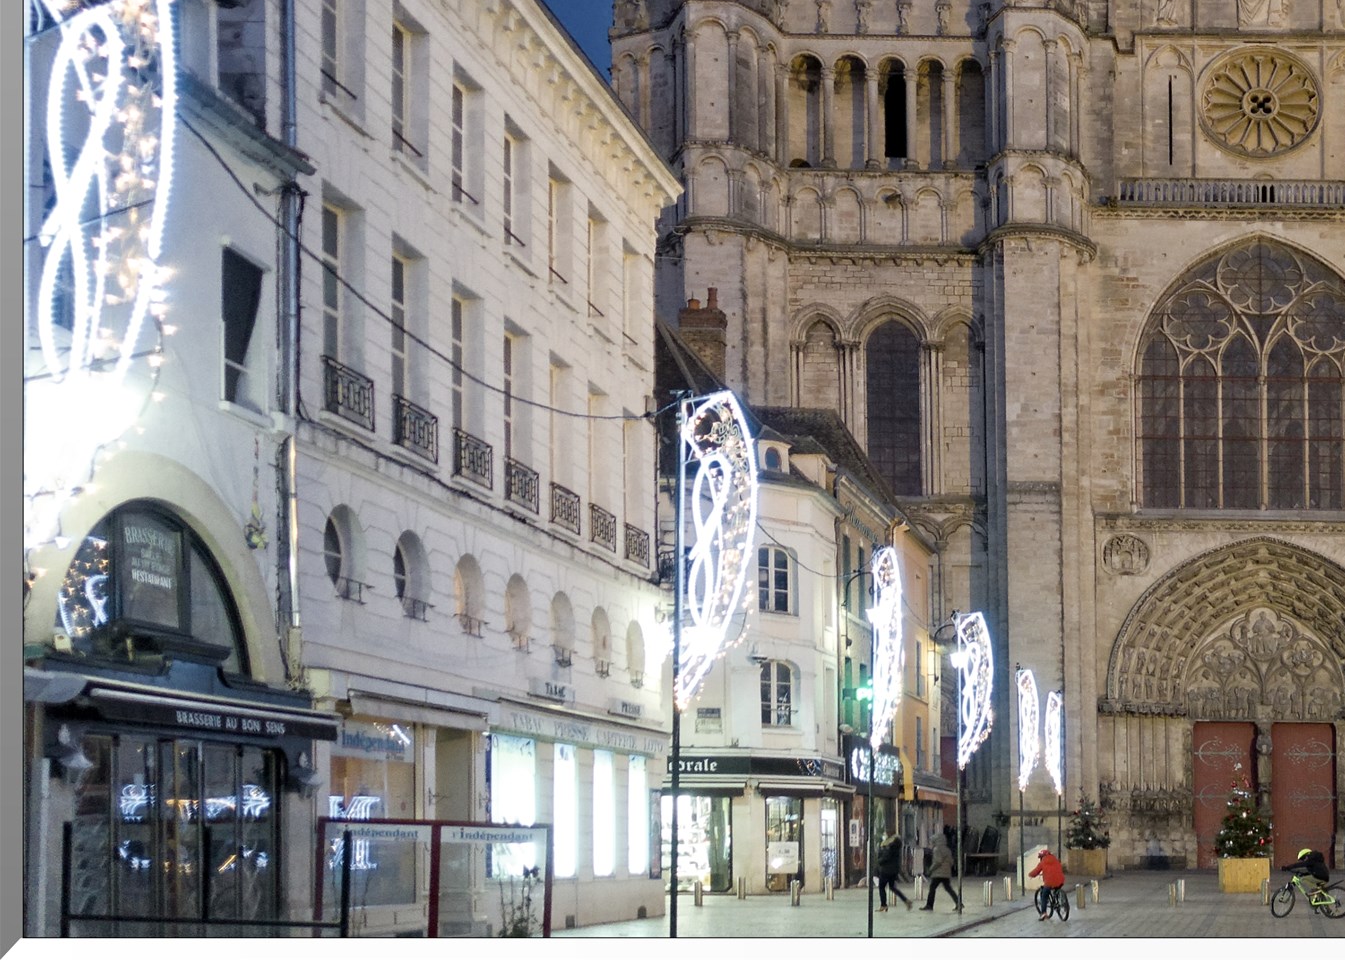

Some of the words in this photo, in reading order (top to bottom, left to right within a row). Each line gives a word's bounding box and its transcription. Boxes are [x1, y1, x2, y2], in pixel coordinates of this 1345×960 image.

[176, 710, 221, 728] BRASSERIE
[226, 717, 237, 729] AU
[242, 719, 260, 732] BON
[265, 721, 285, 734] SENS
